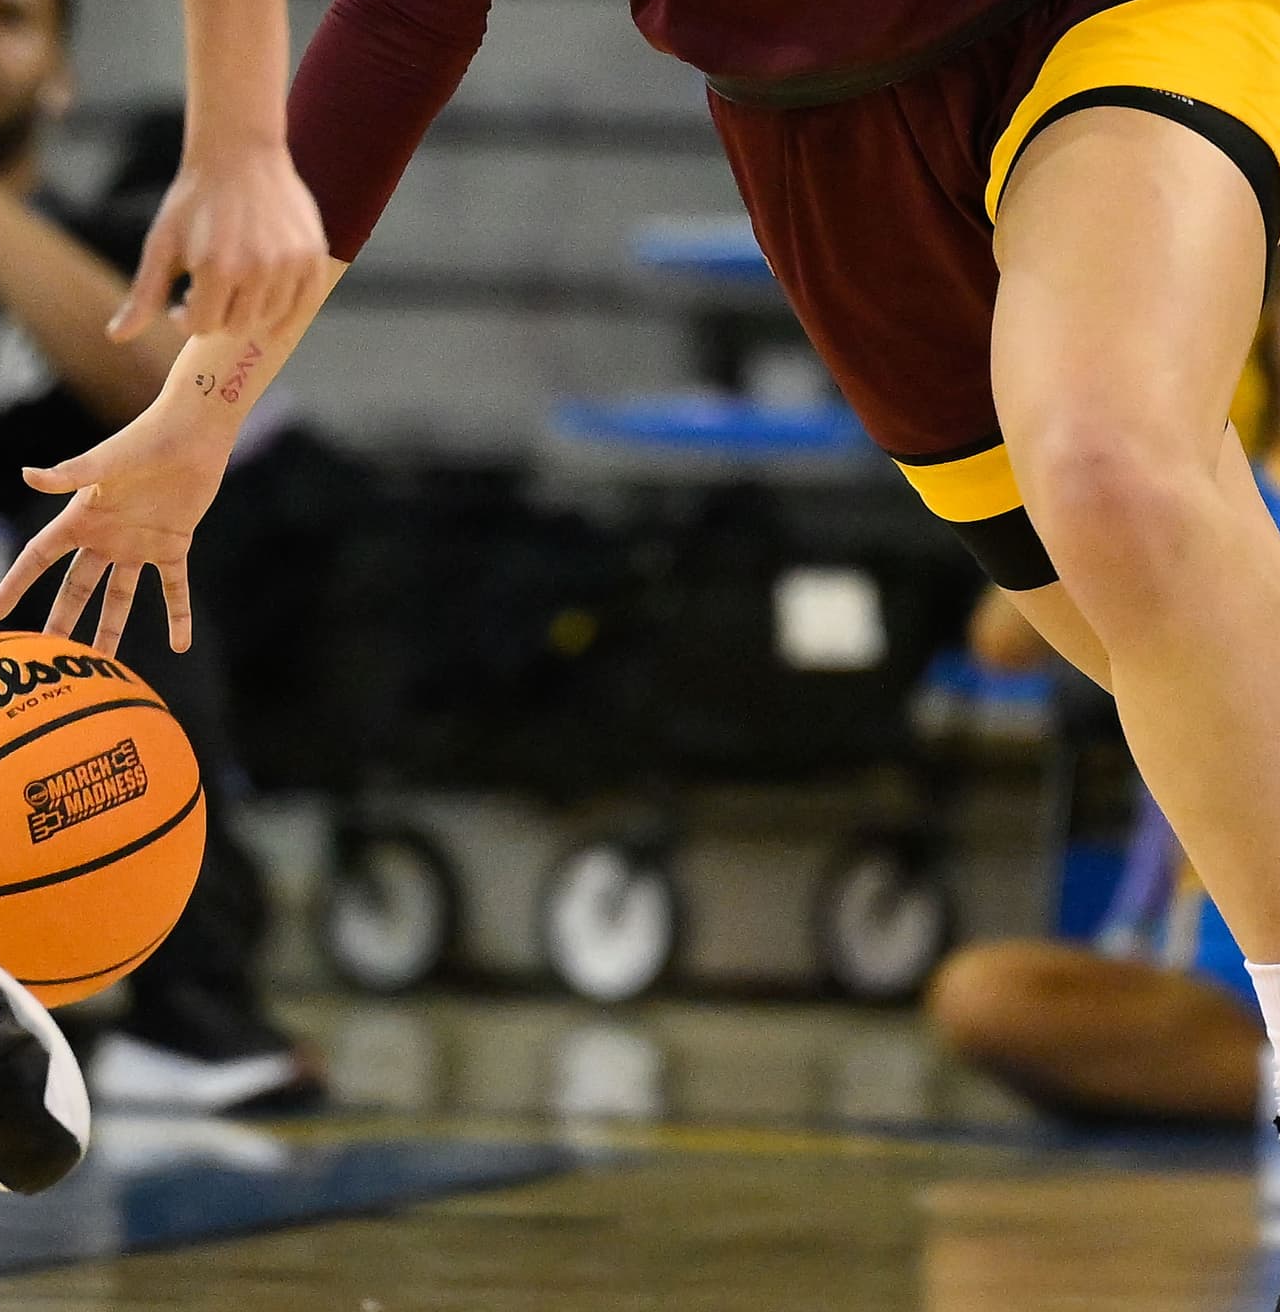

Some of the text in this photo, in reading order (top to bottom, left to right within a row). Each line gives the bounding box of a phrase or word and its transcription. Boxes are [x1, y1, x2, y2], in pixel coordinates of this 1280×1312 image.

[6, 684, 73, 719] EVO NXT
[46, 756, 112, 800] MARCH
[63, 765, 147, 817] MADNESS
